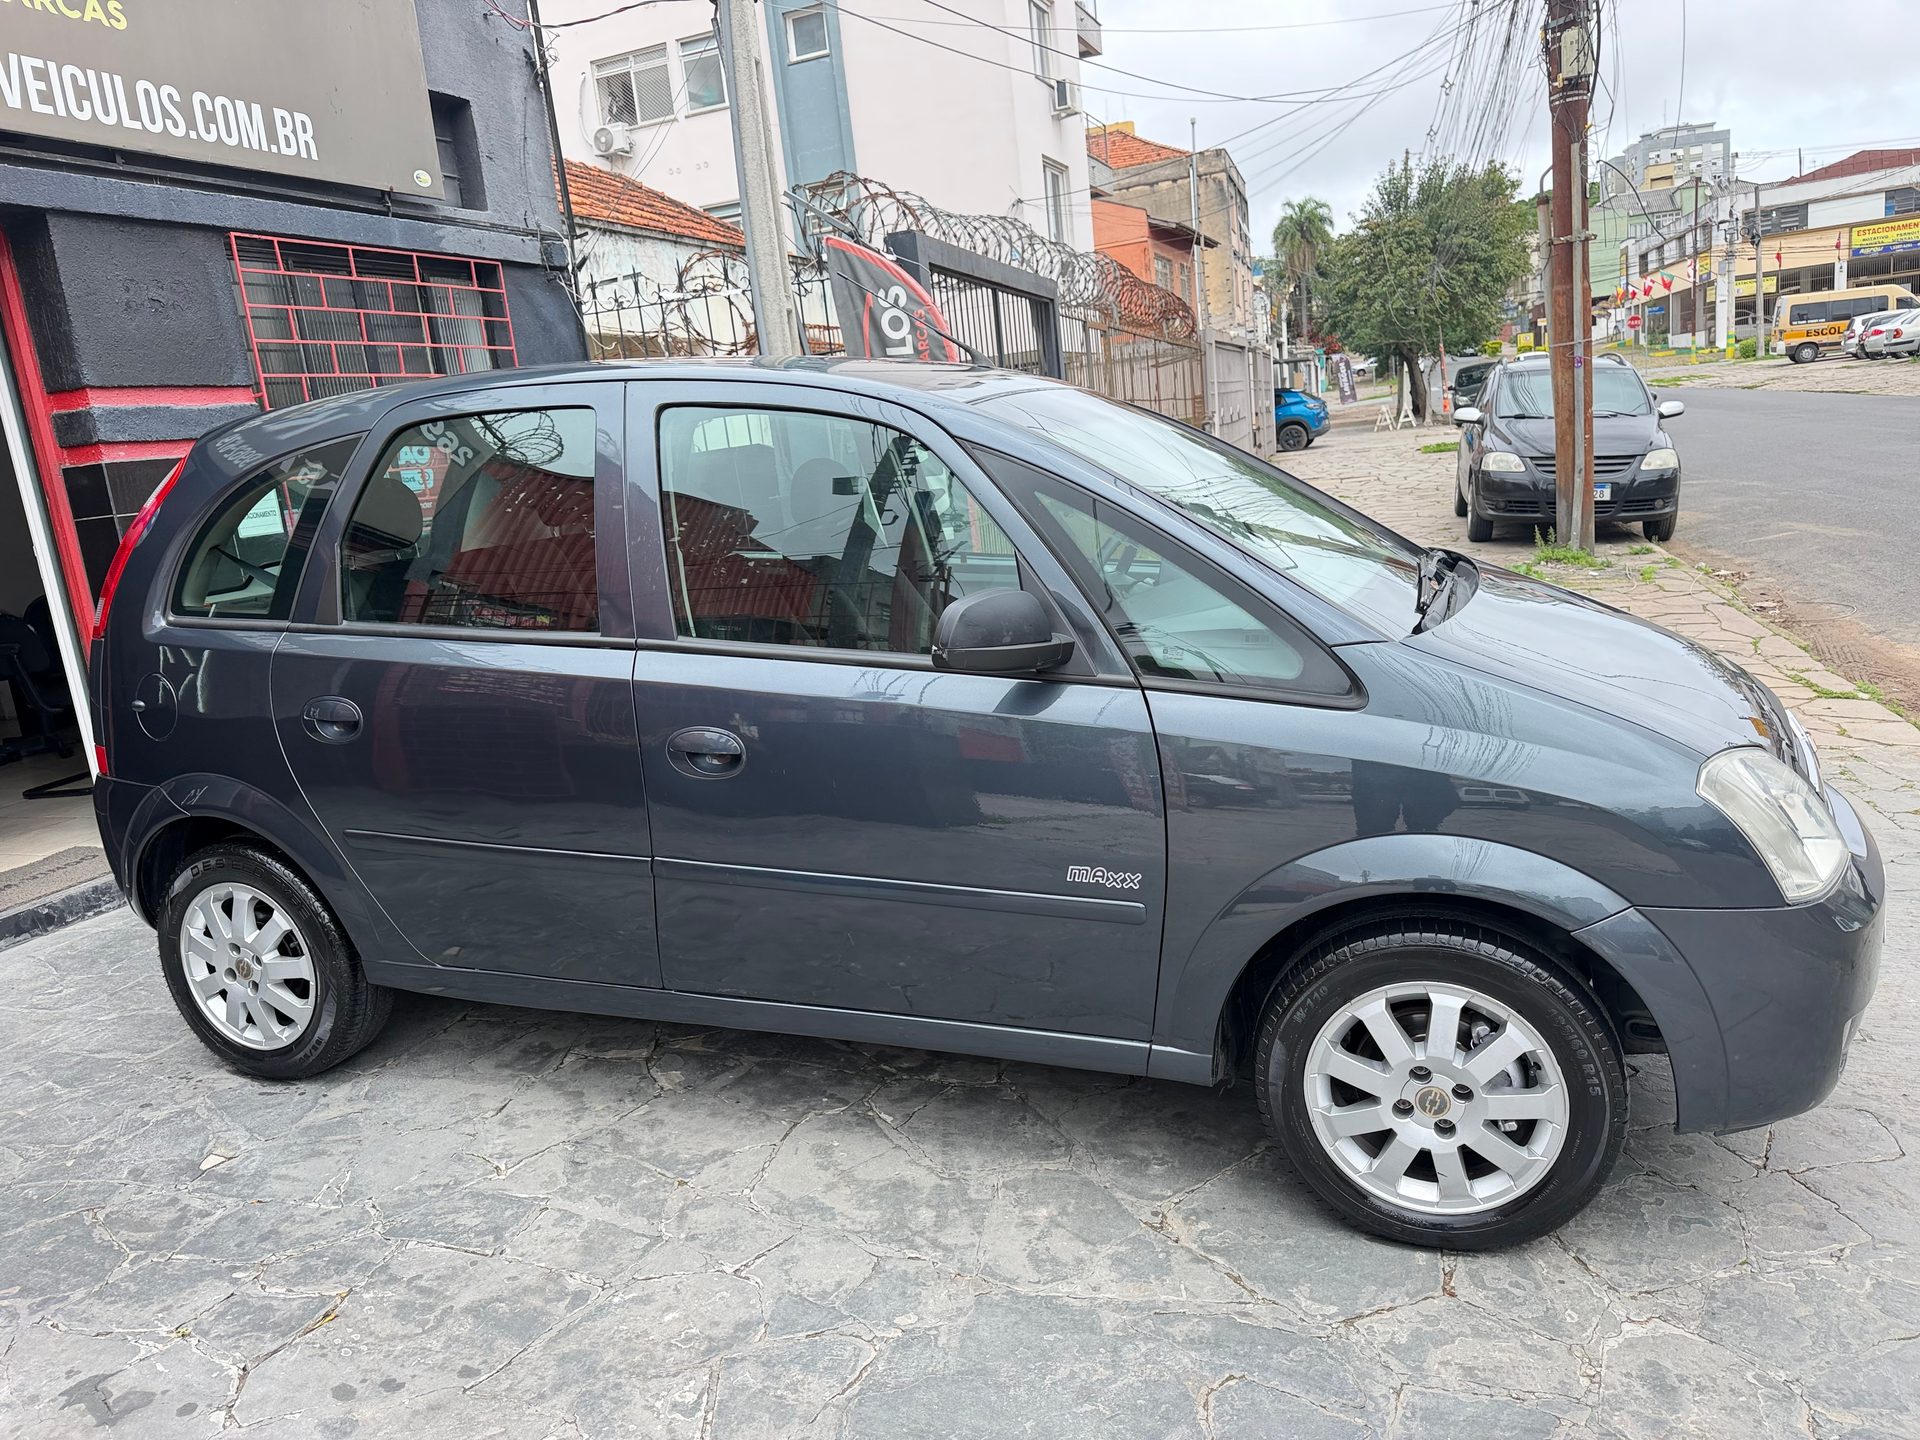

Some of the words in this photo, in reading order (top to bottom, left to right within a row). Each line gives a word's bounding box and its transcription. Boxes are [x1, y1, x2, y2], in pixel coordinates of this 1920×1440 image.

[20, 0, 128, 30] CAS
[878, 285, 914, 356] LOS
[1593, 489, 1604, 499] 28
